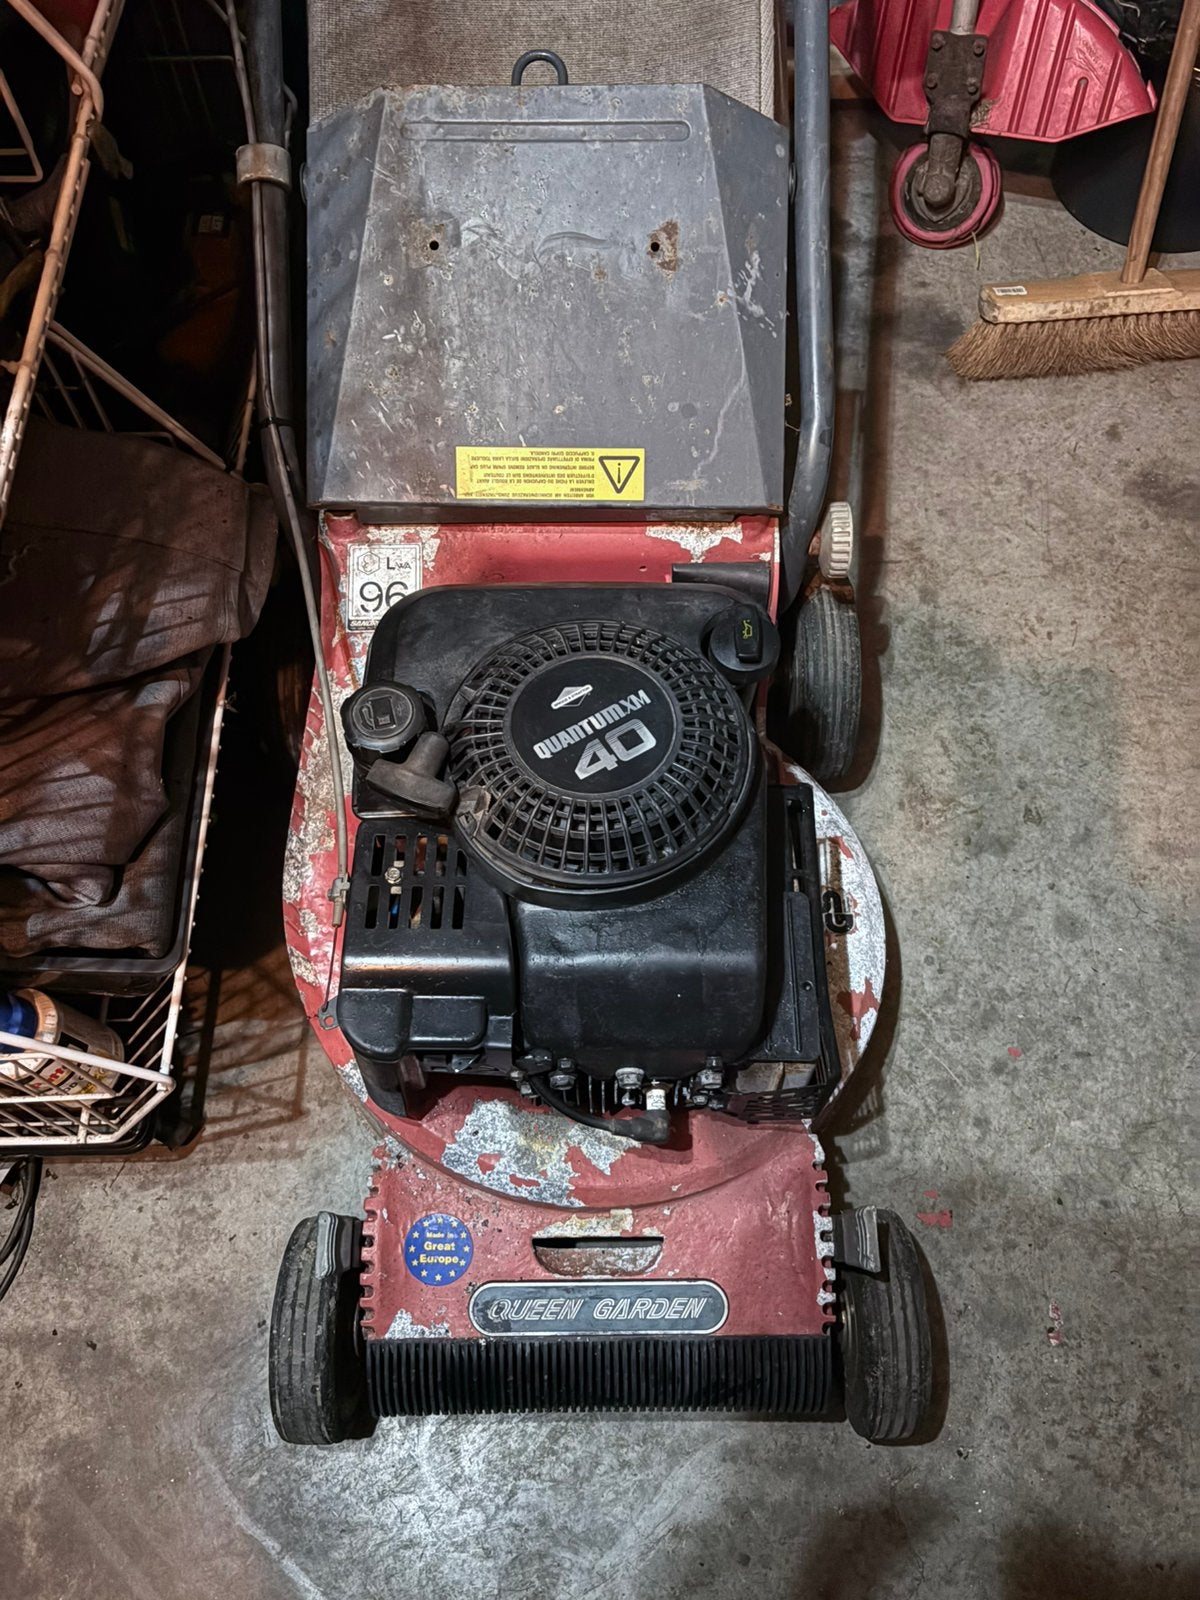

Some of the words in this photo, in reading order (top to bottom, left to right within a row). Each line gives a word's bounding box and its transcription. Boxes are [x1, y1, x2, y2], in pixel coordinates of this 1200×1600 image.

[574, 718, 657, 780] 40
[424, 1241, 456, 1250] Great
[419, 1254, 459, 1264] Europe
[488, 1298, 585, 1320] QUEEN
[593, 1297, 706, 1320] GARDEN
